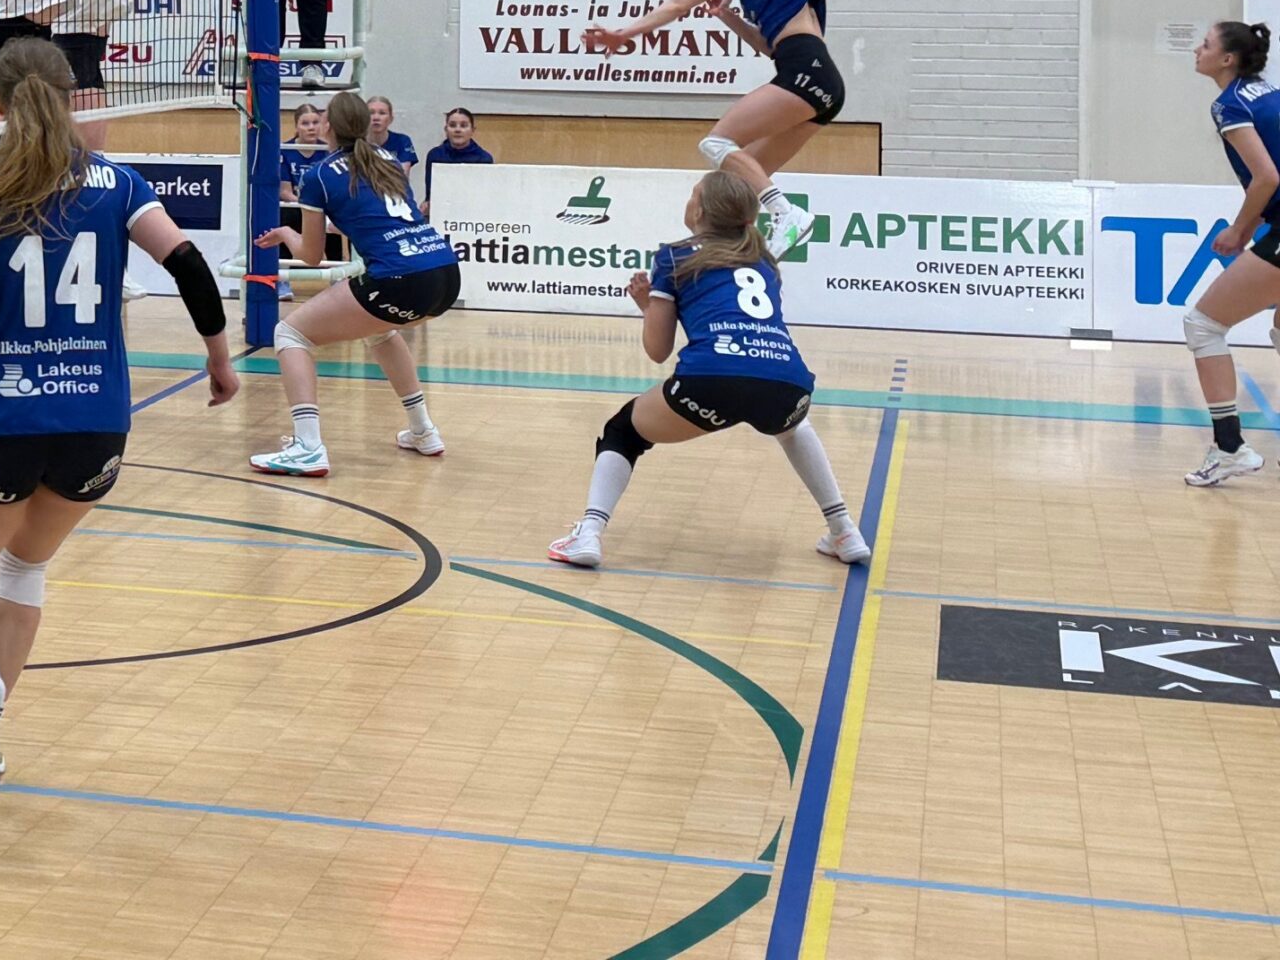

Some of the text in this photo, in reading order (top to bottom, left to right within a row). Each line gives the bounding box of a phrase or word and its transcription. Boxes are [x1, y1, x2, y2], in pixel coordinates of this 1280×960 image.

[495, 0, 579, 17] Lounas-
[588, 0, 609, 21] ja
[519, 63, 738, 84] www.vallesmanni.net
[443, 219, 531, 235] tampereen
[840, 212, 1084, 256] APTEEKKI
[8, 231, 102, 328] 14
[916, 261, 1085, 280] ORIVEDEN APTEEKKI
[733, 267, 774, 320] 8
[826, 277, 1085, 300] KORKEAKOSKEN SIVUAPTEEKKI
[37, 362, 103, 378] Lakeus
[42, 380, 100, 394] Office
